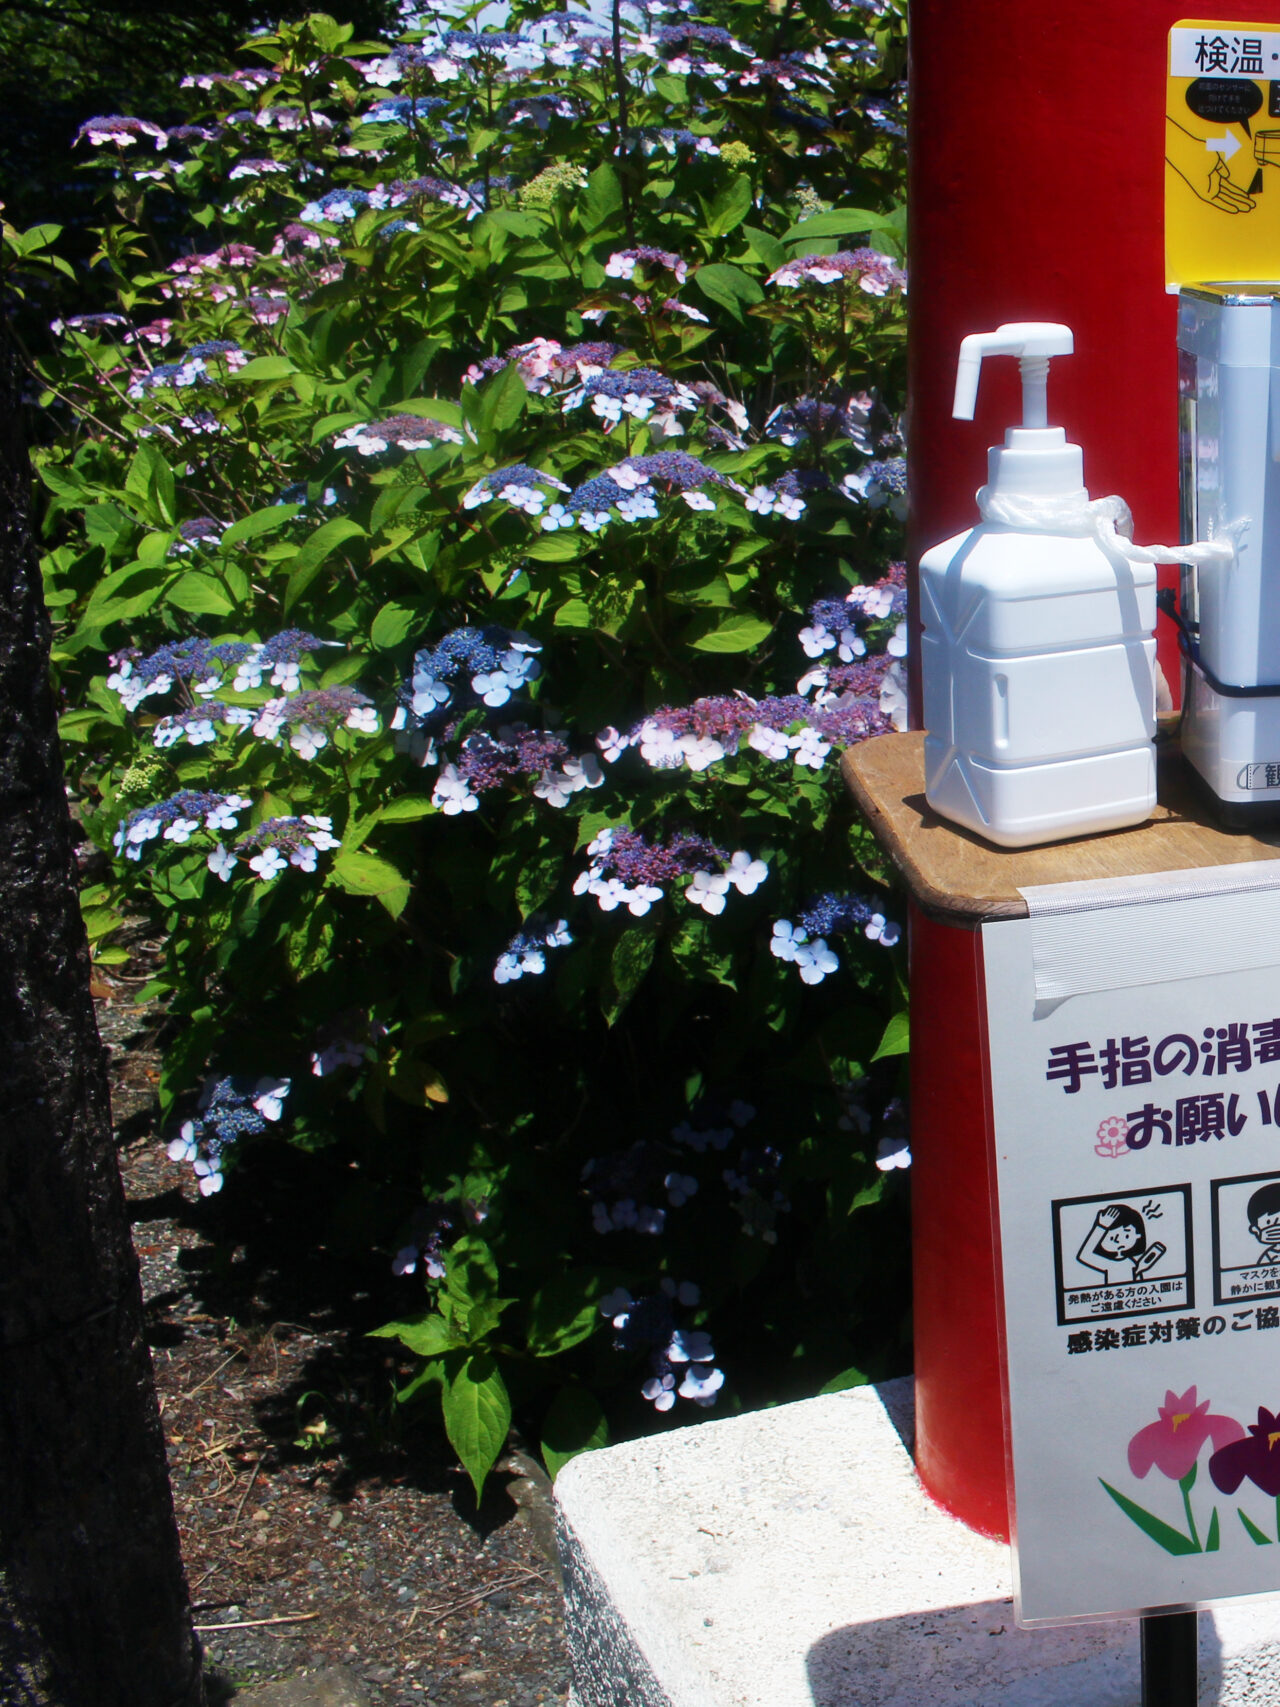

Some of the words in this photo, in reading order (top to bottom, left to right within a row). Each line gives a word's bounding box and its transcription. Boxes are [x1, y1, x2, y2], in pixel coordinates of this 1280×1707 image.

[1068, 1281, 1183, 1305] 発熱がある方の入園は
[1091, 1296, 1162, 1313] ご遠慮ください
